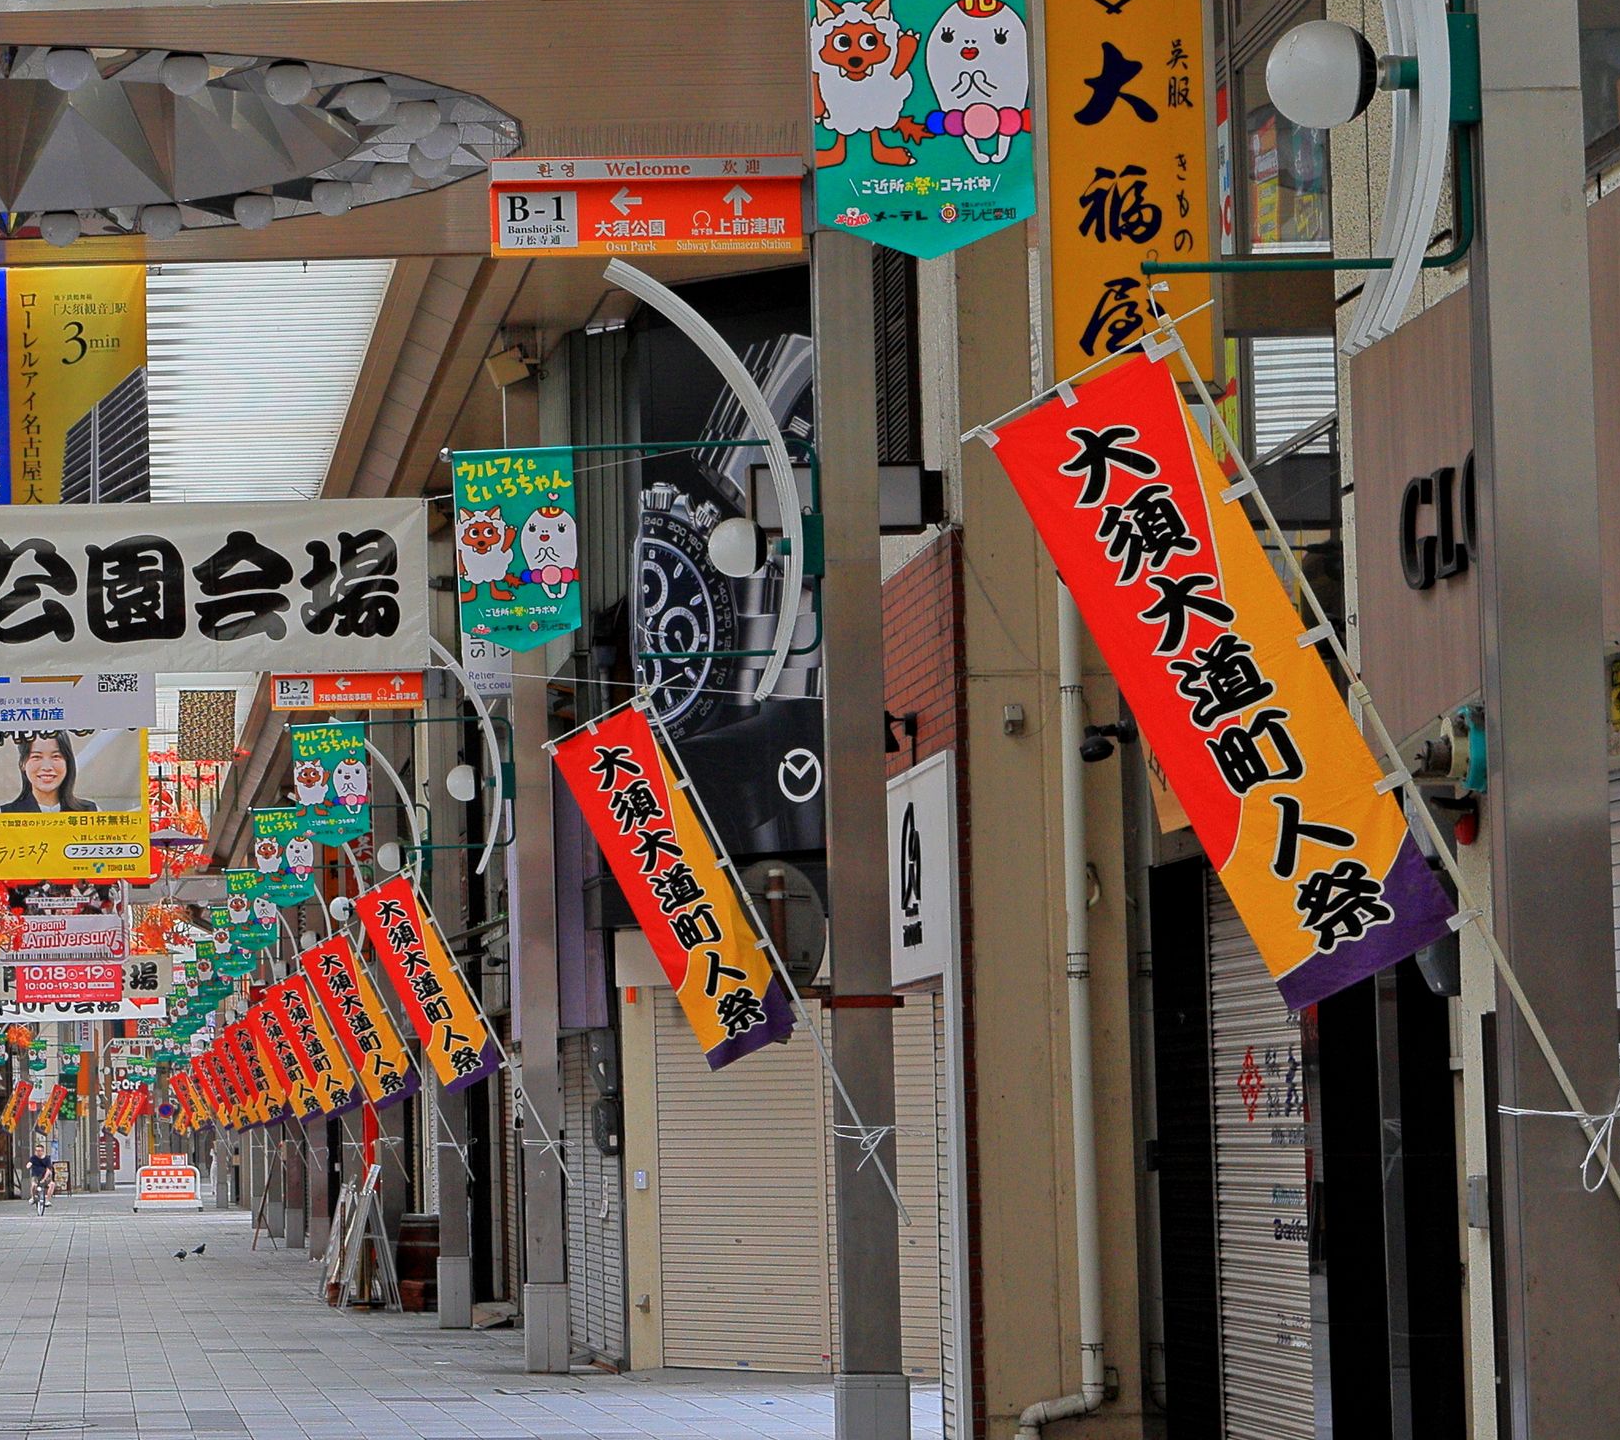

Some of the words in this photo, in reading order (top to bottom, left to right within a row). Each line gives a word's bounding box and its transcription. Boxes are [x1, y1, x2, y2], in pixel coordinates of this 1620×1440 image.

[605, 161, 692, 177] Welcome
[859, 175, 993, 197] ご近所お祭りコラボ中
[506, 195, 566, 223] B-1
[1073, 40, 1164, 359] 大福屋
[1171, 153, 1195, 255] きもの
[960, 207, 1018, 222] テレビ愛知
[507, 224, 570, 235] Banshoji-St.
[594, 218, 666, 238] 大須公園
[714, 217, 786, 236] 上前津駅
[514, 235, 562, 246] 万松寺通
[605, 241, 627, 252] Osu
[629, 240, 657, 252] Park
[676, 240, 709, 252] Subway
[710, 239, 760, 250] Kamimaezu
[761, 238, 792, 250] Station
[463, 471, 573, 504] といろちゃん
[643, 516, 664, 526] 240
[667, 521, 687, 537] 200
[279, 680, 310, 695] B-2
[1060, 421, 1398, 955] 大須大道町人祭
[298, 737, 364, 757] といろちゃん
[70, 847, 123, 855] フラノミスタ
[107, 864, 122, 872] TOHO
[123, 864, 136, 872] GAS
[589, 744, 769, 1041] 大須大道町人祭
[375, 898, 484, 1078] 大須大道町人祭
[319, 952, 406, 1097] 大須大道町人祭
[281, 990, 352, 1108] 大須大道町人祭
